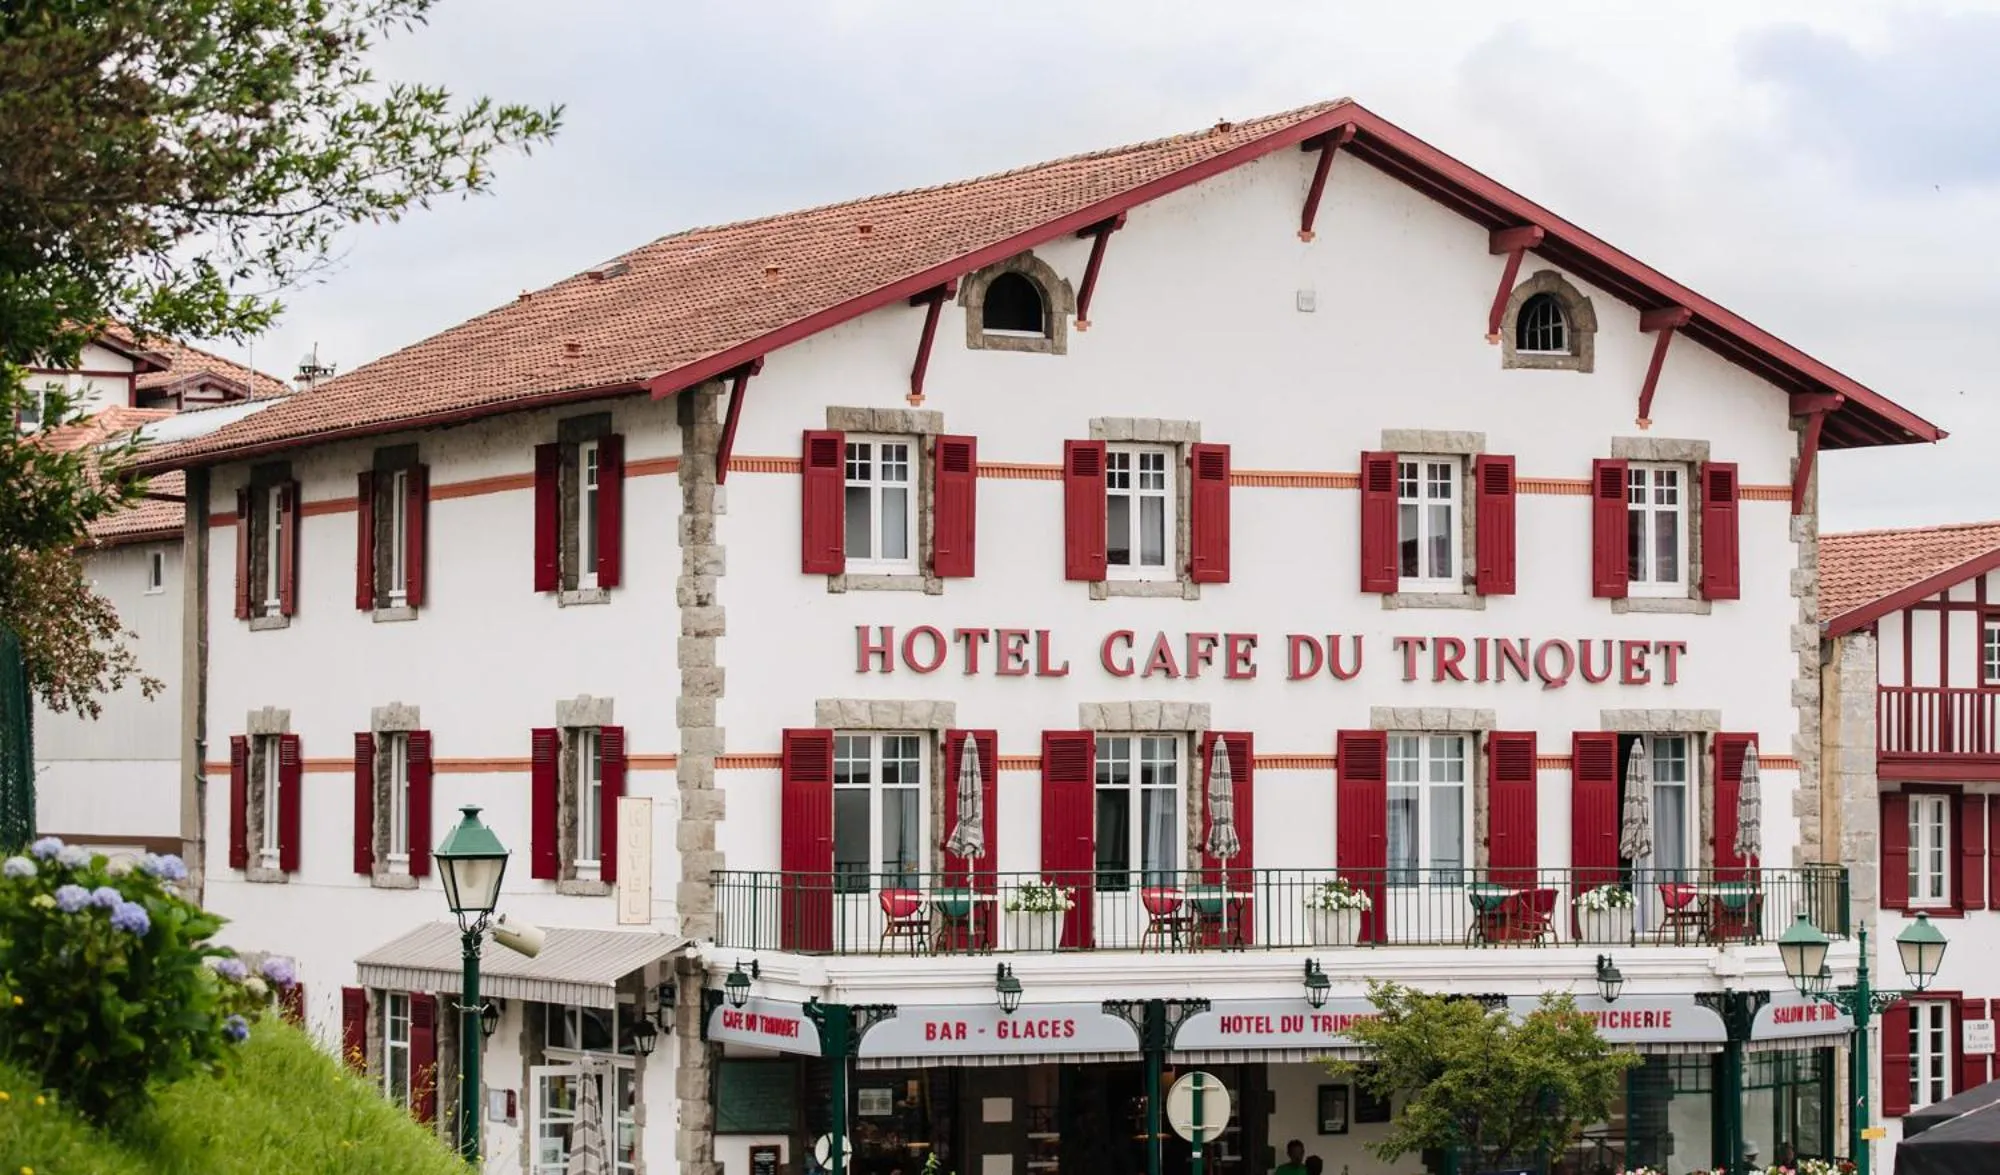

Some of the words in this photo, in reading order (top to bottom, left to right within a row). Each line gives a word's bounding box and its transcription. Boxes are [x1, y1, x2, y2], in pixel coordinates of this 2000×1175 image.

[857, 624, 1070, 677] HOTEL
[1101, 629, 1259, 680] CAFE
[1287, 634, 1364, 682] DU
[1394, 636, 1687, 690] TRINQUET
[723, 1009, 744, 1030] CAFE
[746, 1013, 758, 1032] DU
[925, 1020, 968, 1041] BAR
[995, 1018, 1077, 1040] GLACES
[1220, 1014, 1275, 1034] HOTEL
[1281, 1014, 1305, 1034] DU
[1311, 1014, 1384, 1034] TRIN
